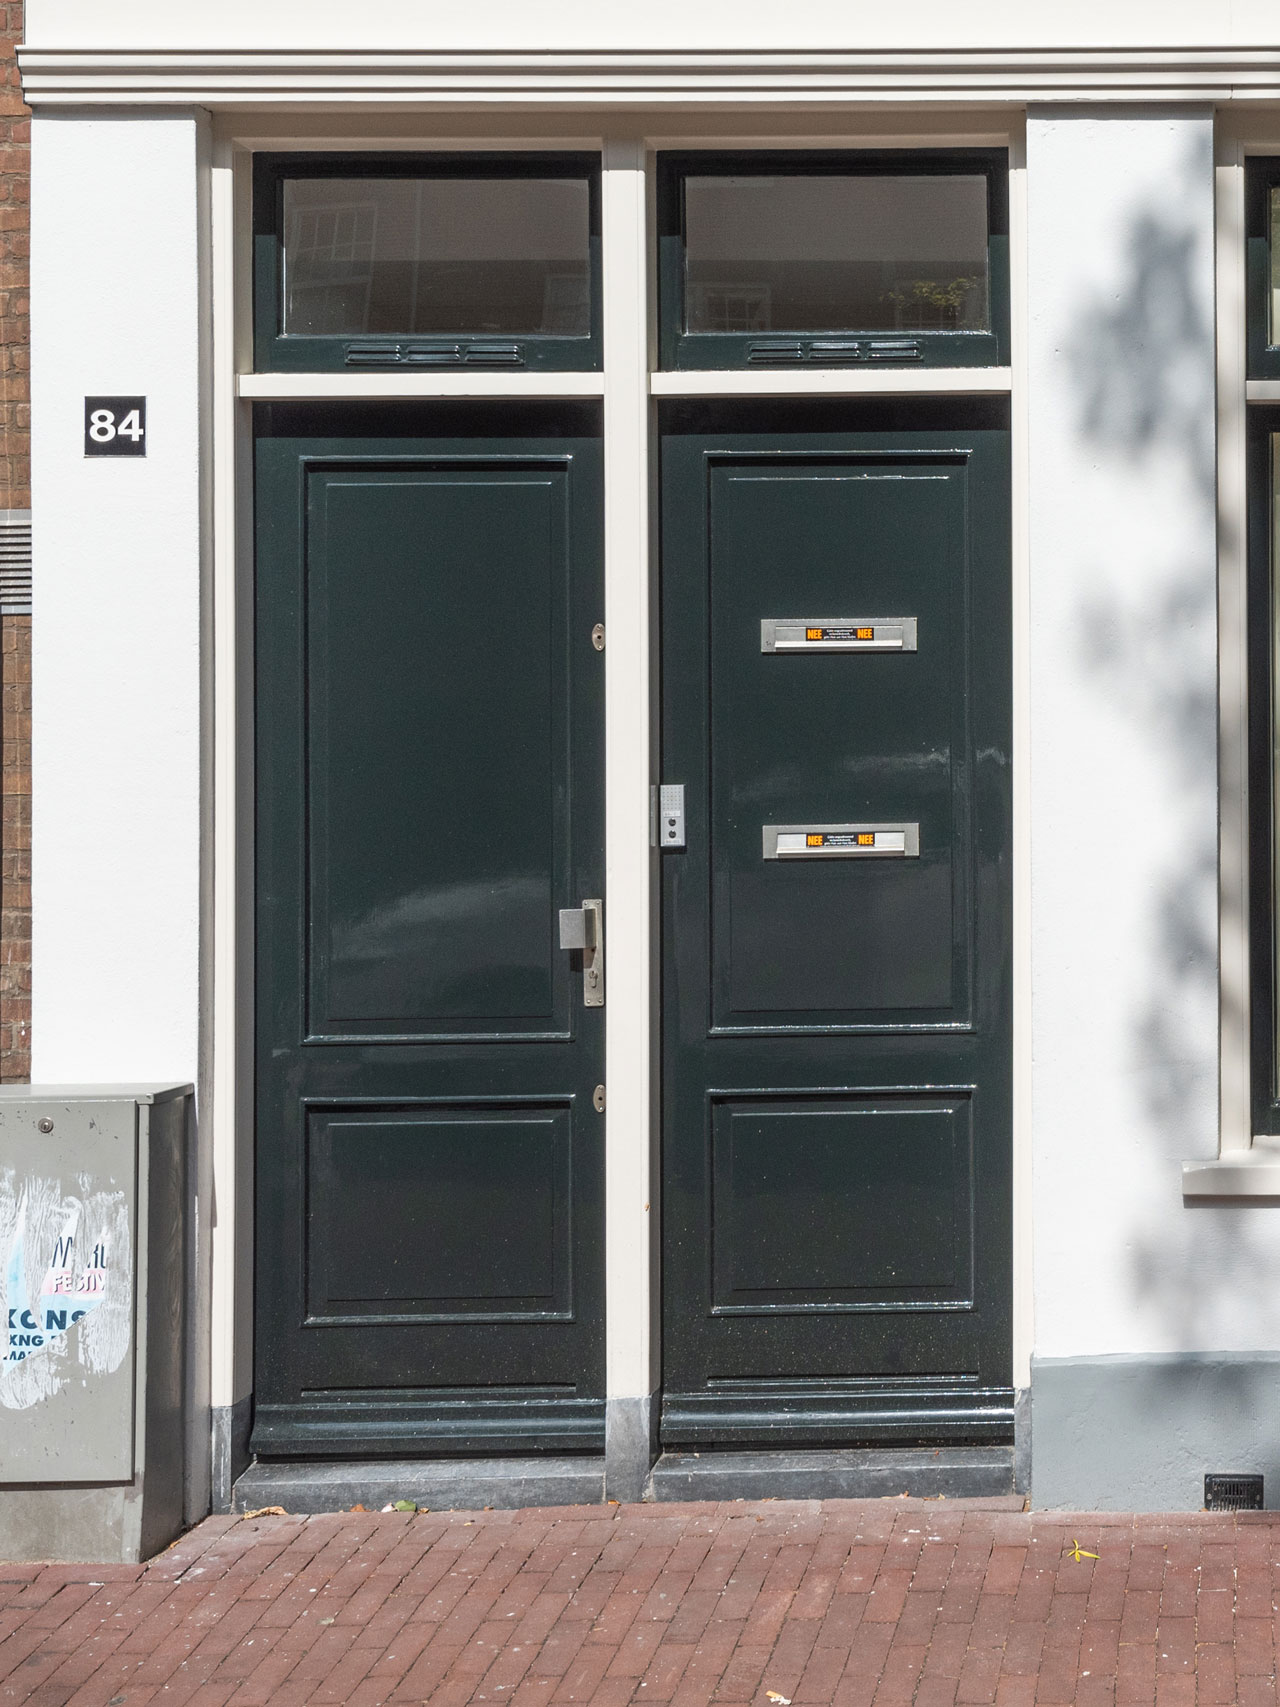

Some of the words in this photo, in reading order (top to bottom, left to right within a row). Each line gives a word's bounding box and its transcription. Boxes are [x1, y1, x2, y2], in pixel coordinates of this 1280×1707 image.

[90, 409, 144, 442] 84
[808, 629, 822, 640] NEE
[857, 628, 873, 639] NEE
[807, 835, 823, 846] NEE
[858, 834, 874, 845] NEE
